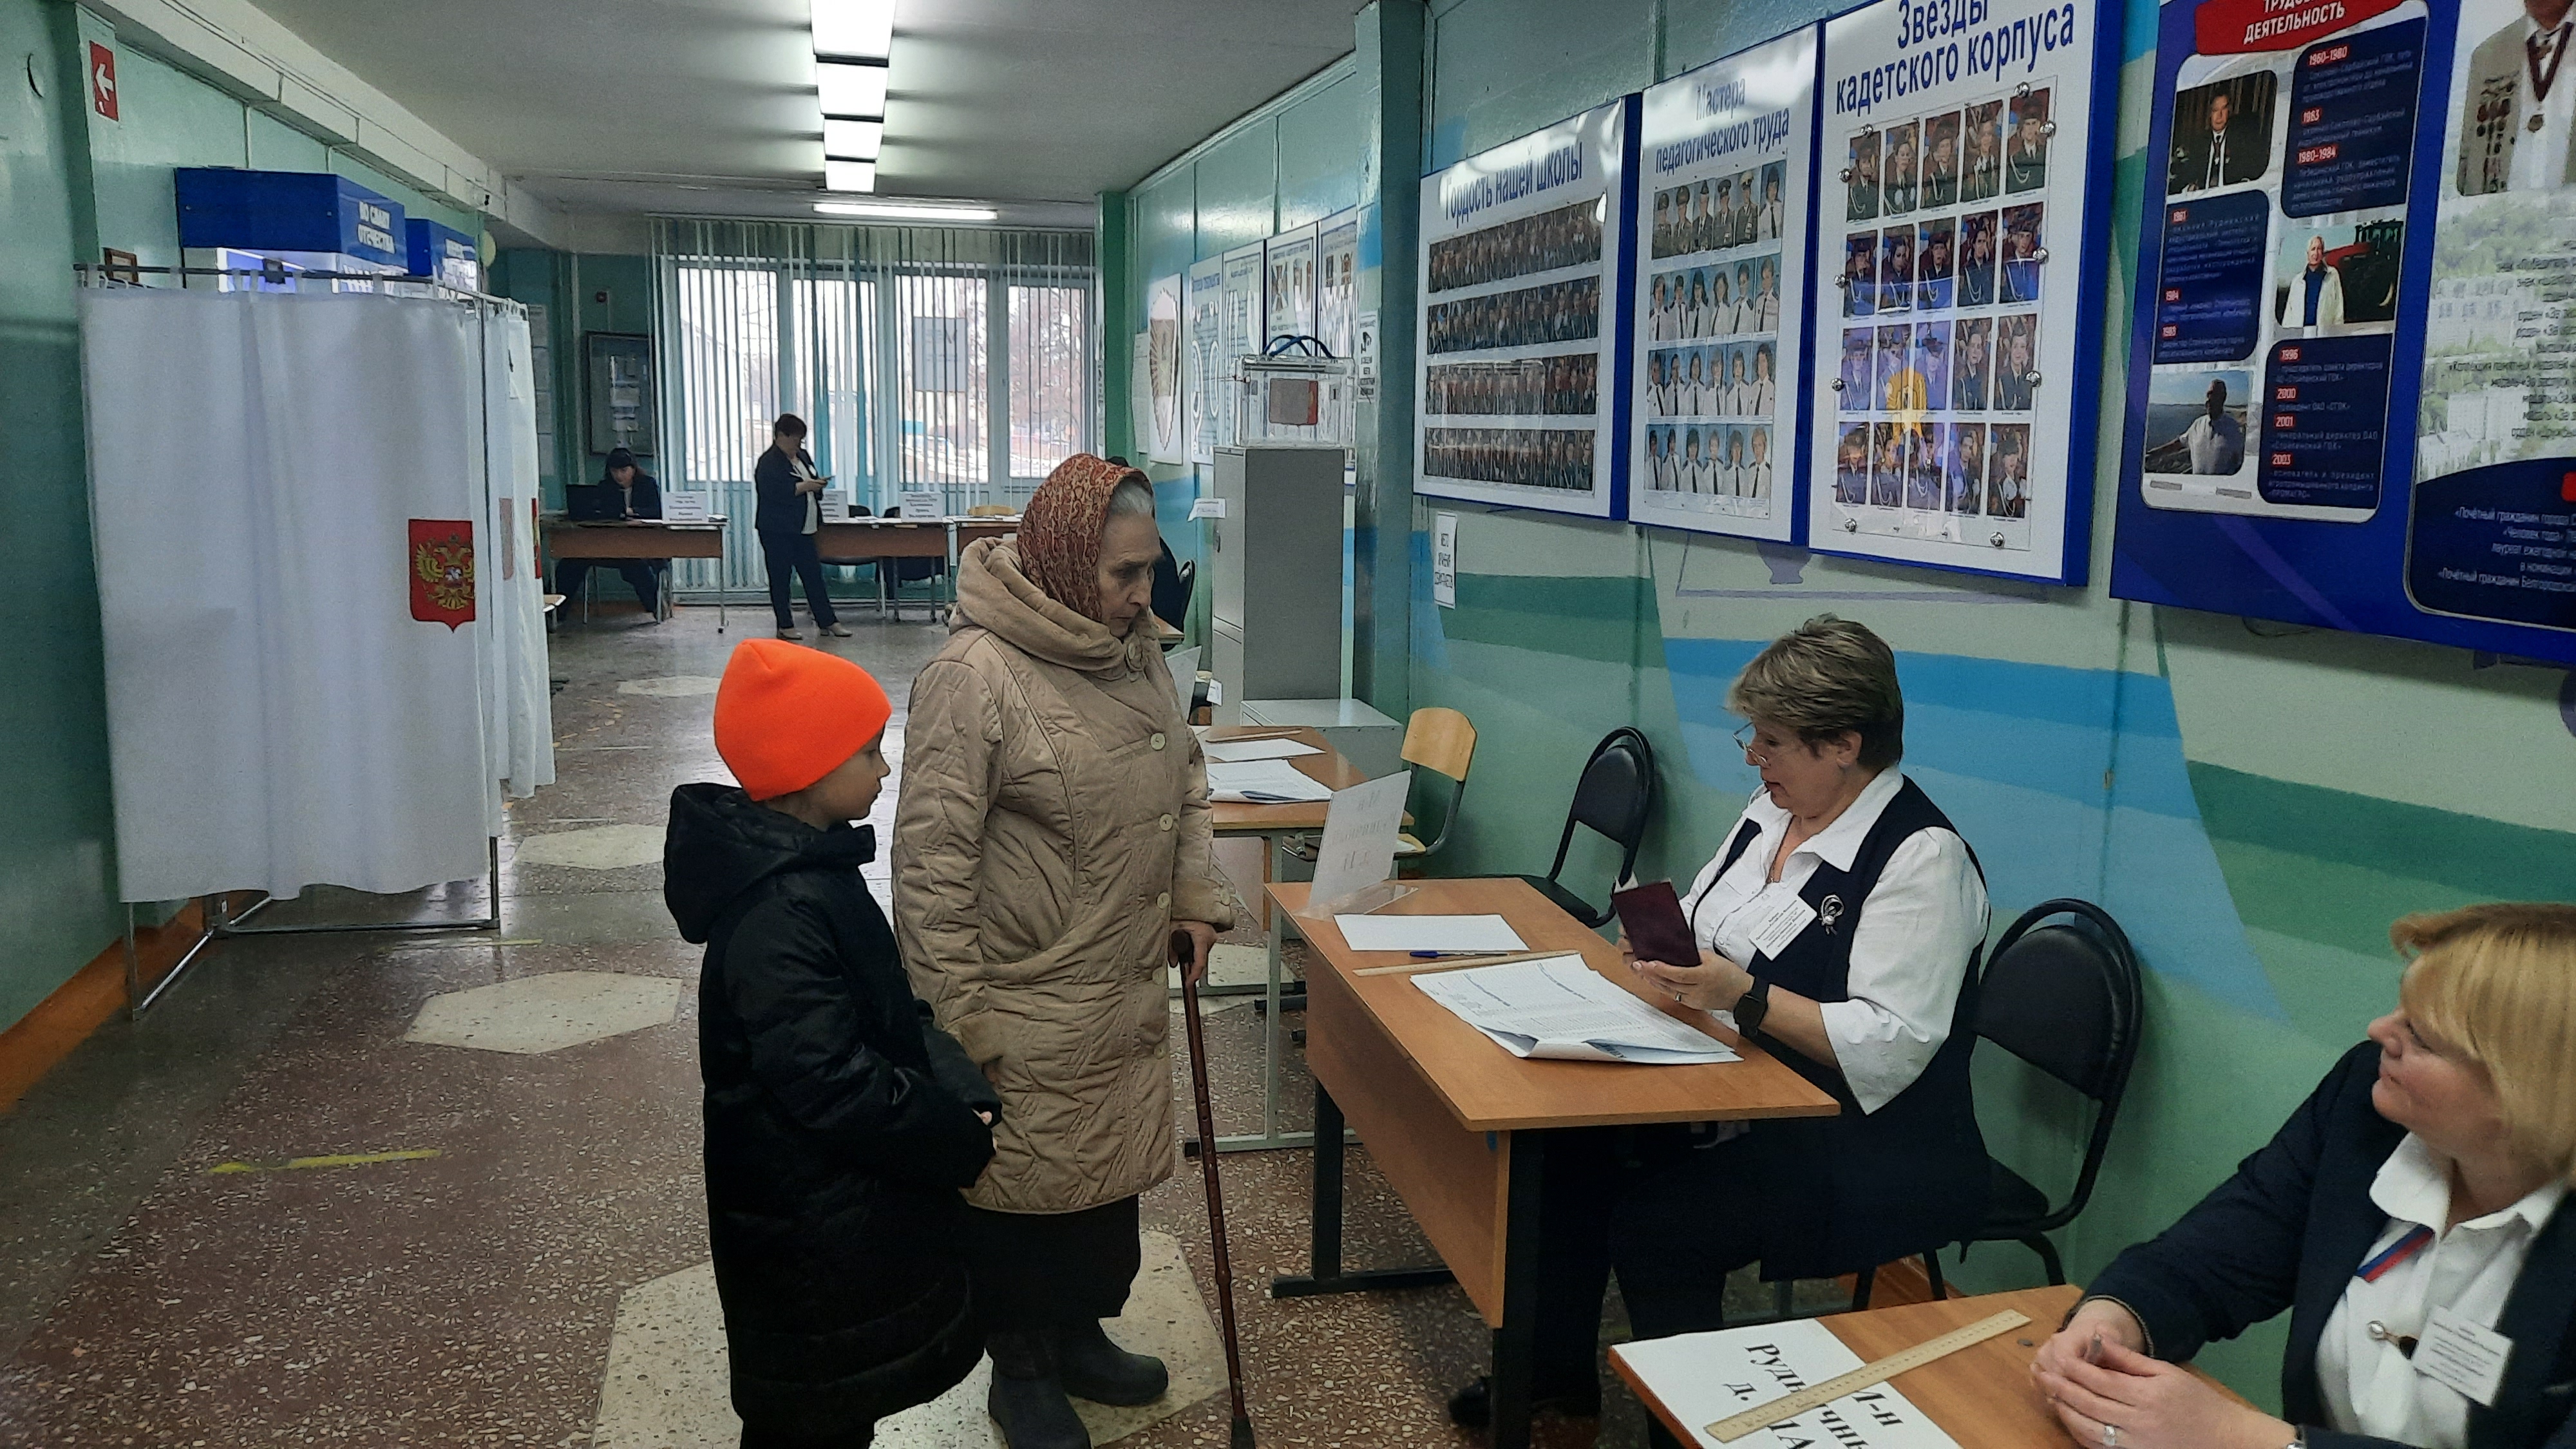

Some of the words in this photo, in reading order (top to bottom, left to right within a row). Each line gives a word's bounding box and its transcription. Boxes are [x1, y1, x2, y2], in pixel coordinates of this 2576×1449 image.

[1897, 0, 1987, 49] Звезды
[2243, 1, 2345, 45] ДЕЯТЕЛЬНОСТЬ
[1836, 42, 1958, 117] кадетского
[1967, 3, 2074, 82] корпуса
[1696, 78, 1745, 120] Мастера
[1656, 120, 1749, 176] педагогического
[1753, 107, 1790, 155] труда
[1446, 174, 1493, 229] Гордость
[1495, 146, 1533, 206] нашей
[1537, 141, 1582, 193] школы
[2277, 388, 2297, 400] 2000
[2275, 416, 2294, 427] 2001
